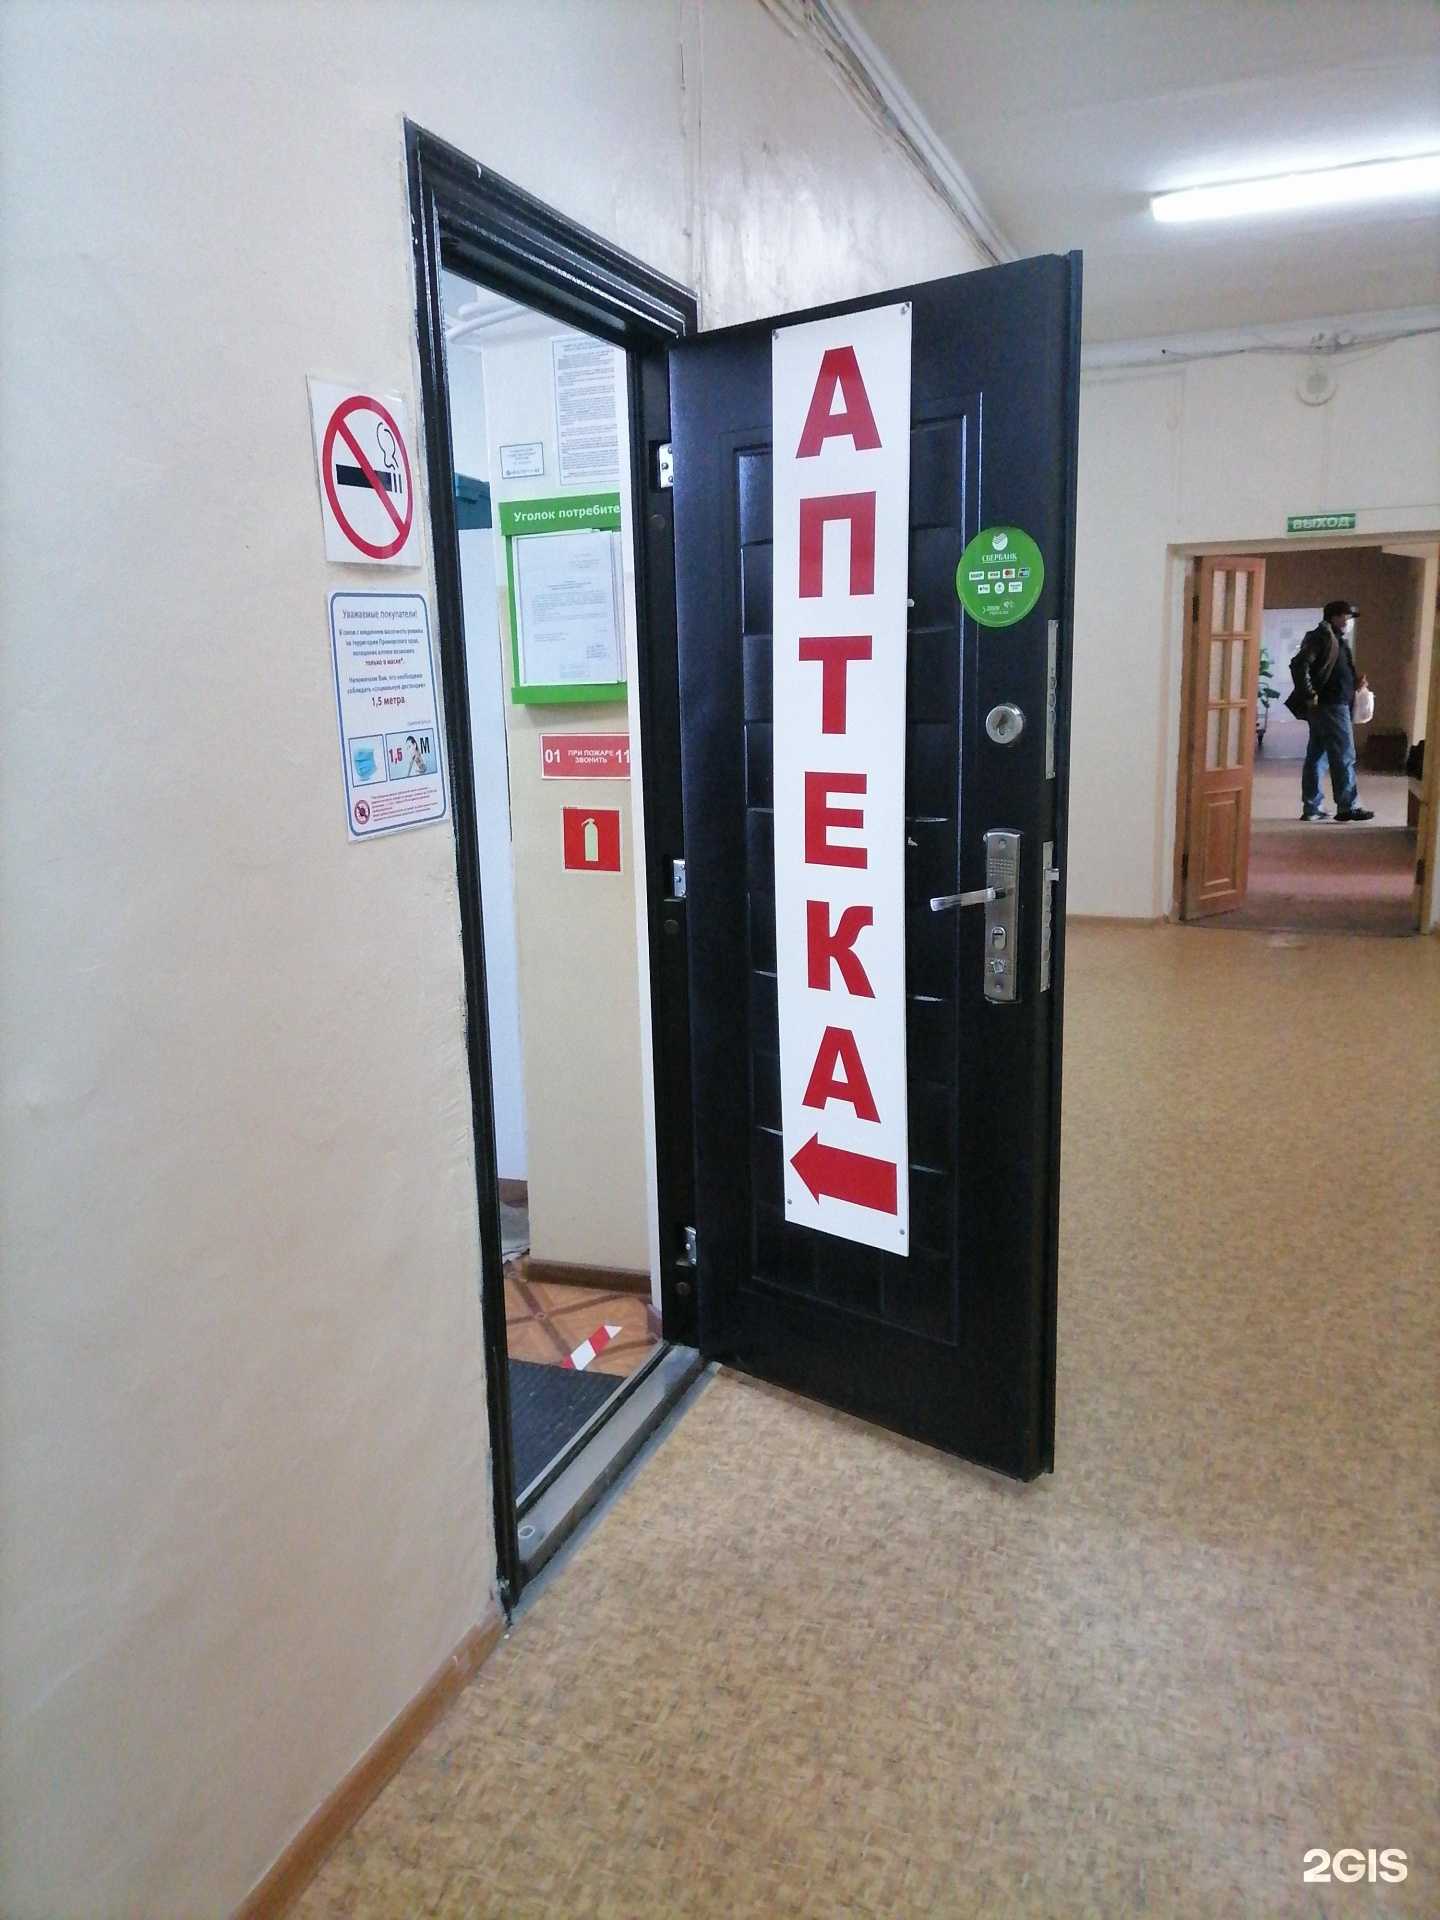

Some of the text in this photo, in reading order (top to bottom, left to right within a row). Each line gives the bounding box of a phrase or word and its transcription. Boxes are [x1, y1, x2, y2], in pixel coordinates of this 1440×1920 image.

[513, 503, 621, 522] Уголок потребите
[1293, 516, 1351, 530] ВЫХОД
[342, 609, 379, 619] Уважаемые
[371, 696, 406, 708] 1,5 метра
[796, 345, 883, 1125] АПТЕКА
[544, 749, 561, 763] 01
[583, 749, 614, 757] ПОЖАРЕ
[615, 749, 631, 763] 11
